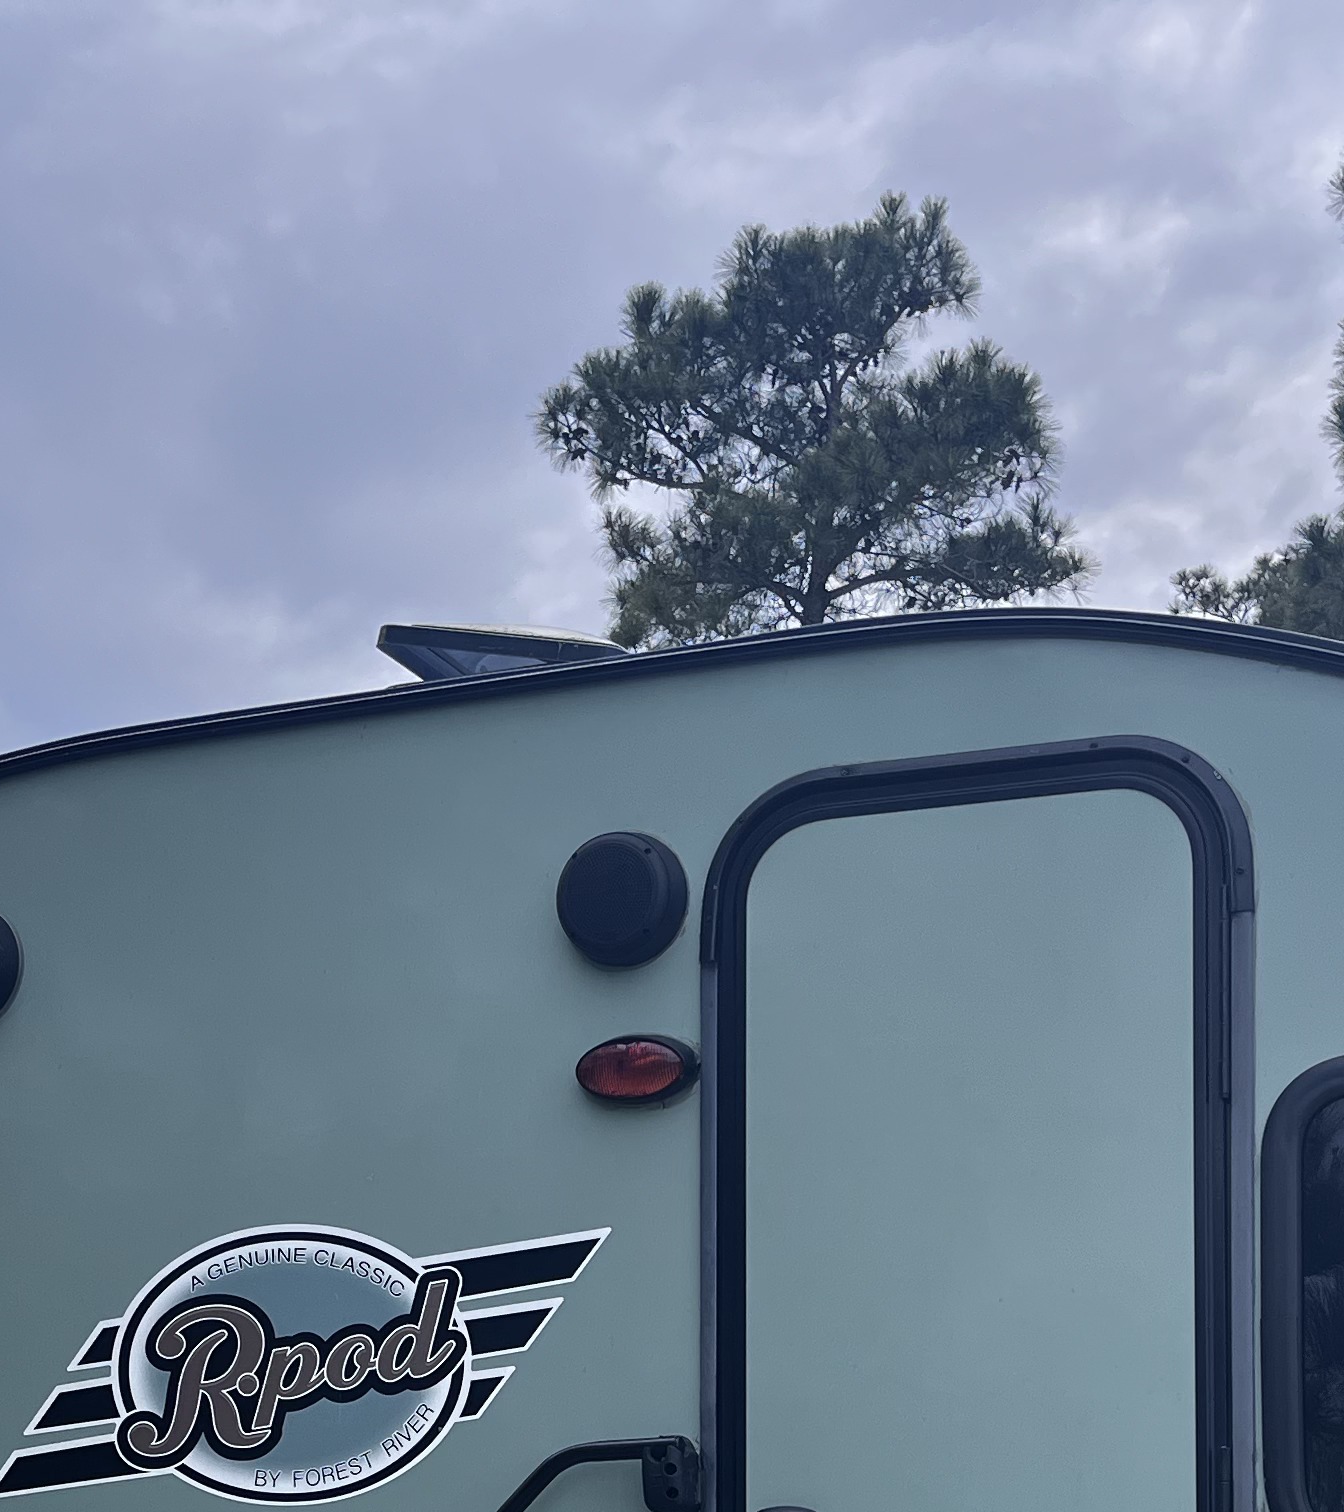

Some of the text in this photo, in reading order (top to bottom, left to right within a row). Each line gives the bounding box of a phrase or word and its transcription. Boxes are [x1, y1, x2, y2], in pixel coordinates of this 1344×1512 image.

[189, 1247, 406, 1298] A GENUINE CLASSIC
[253, 1401, 436, 1489] BY FOREST RIVER
